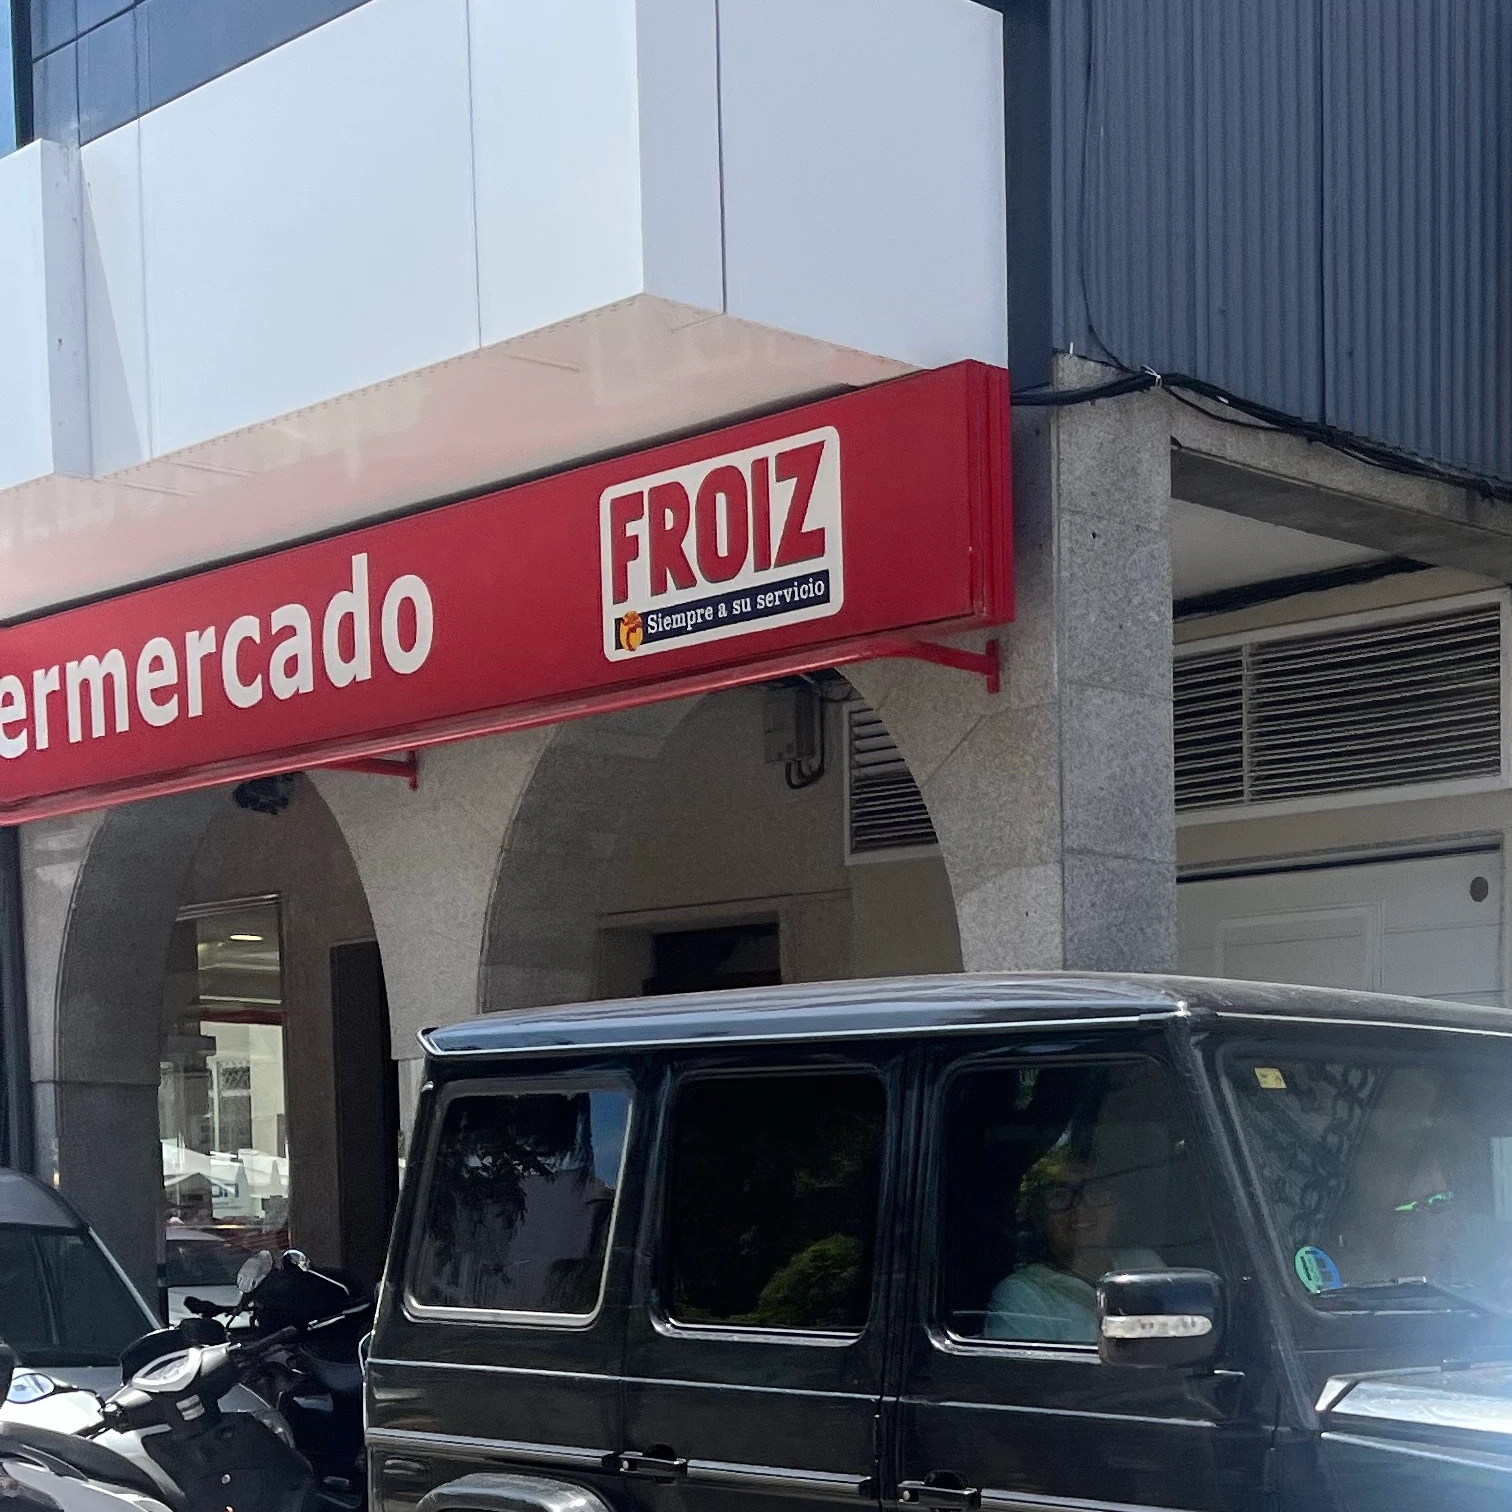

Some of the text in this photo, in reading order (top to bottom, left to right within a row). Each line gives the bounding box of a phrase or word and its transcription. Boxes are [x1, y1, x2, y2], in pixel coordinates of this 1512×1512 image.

[610, 440, 826, 605] FROIZ
[0, 552, 434, 760] ermercado
[647, 577, 826, 634] Siempre a su servicio
